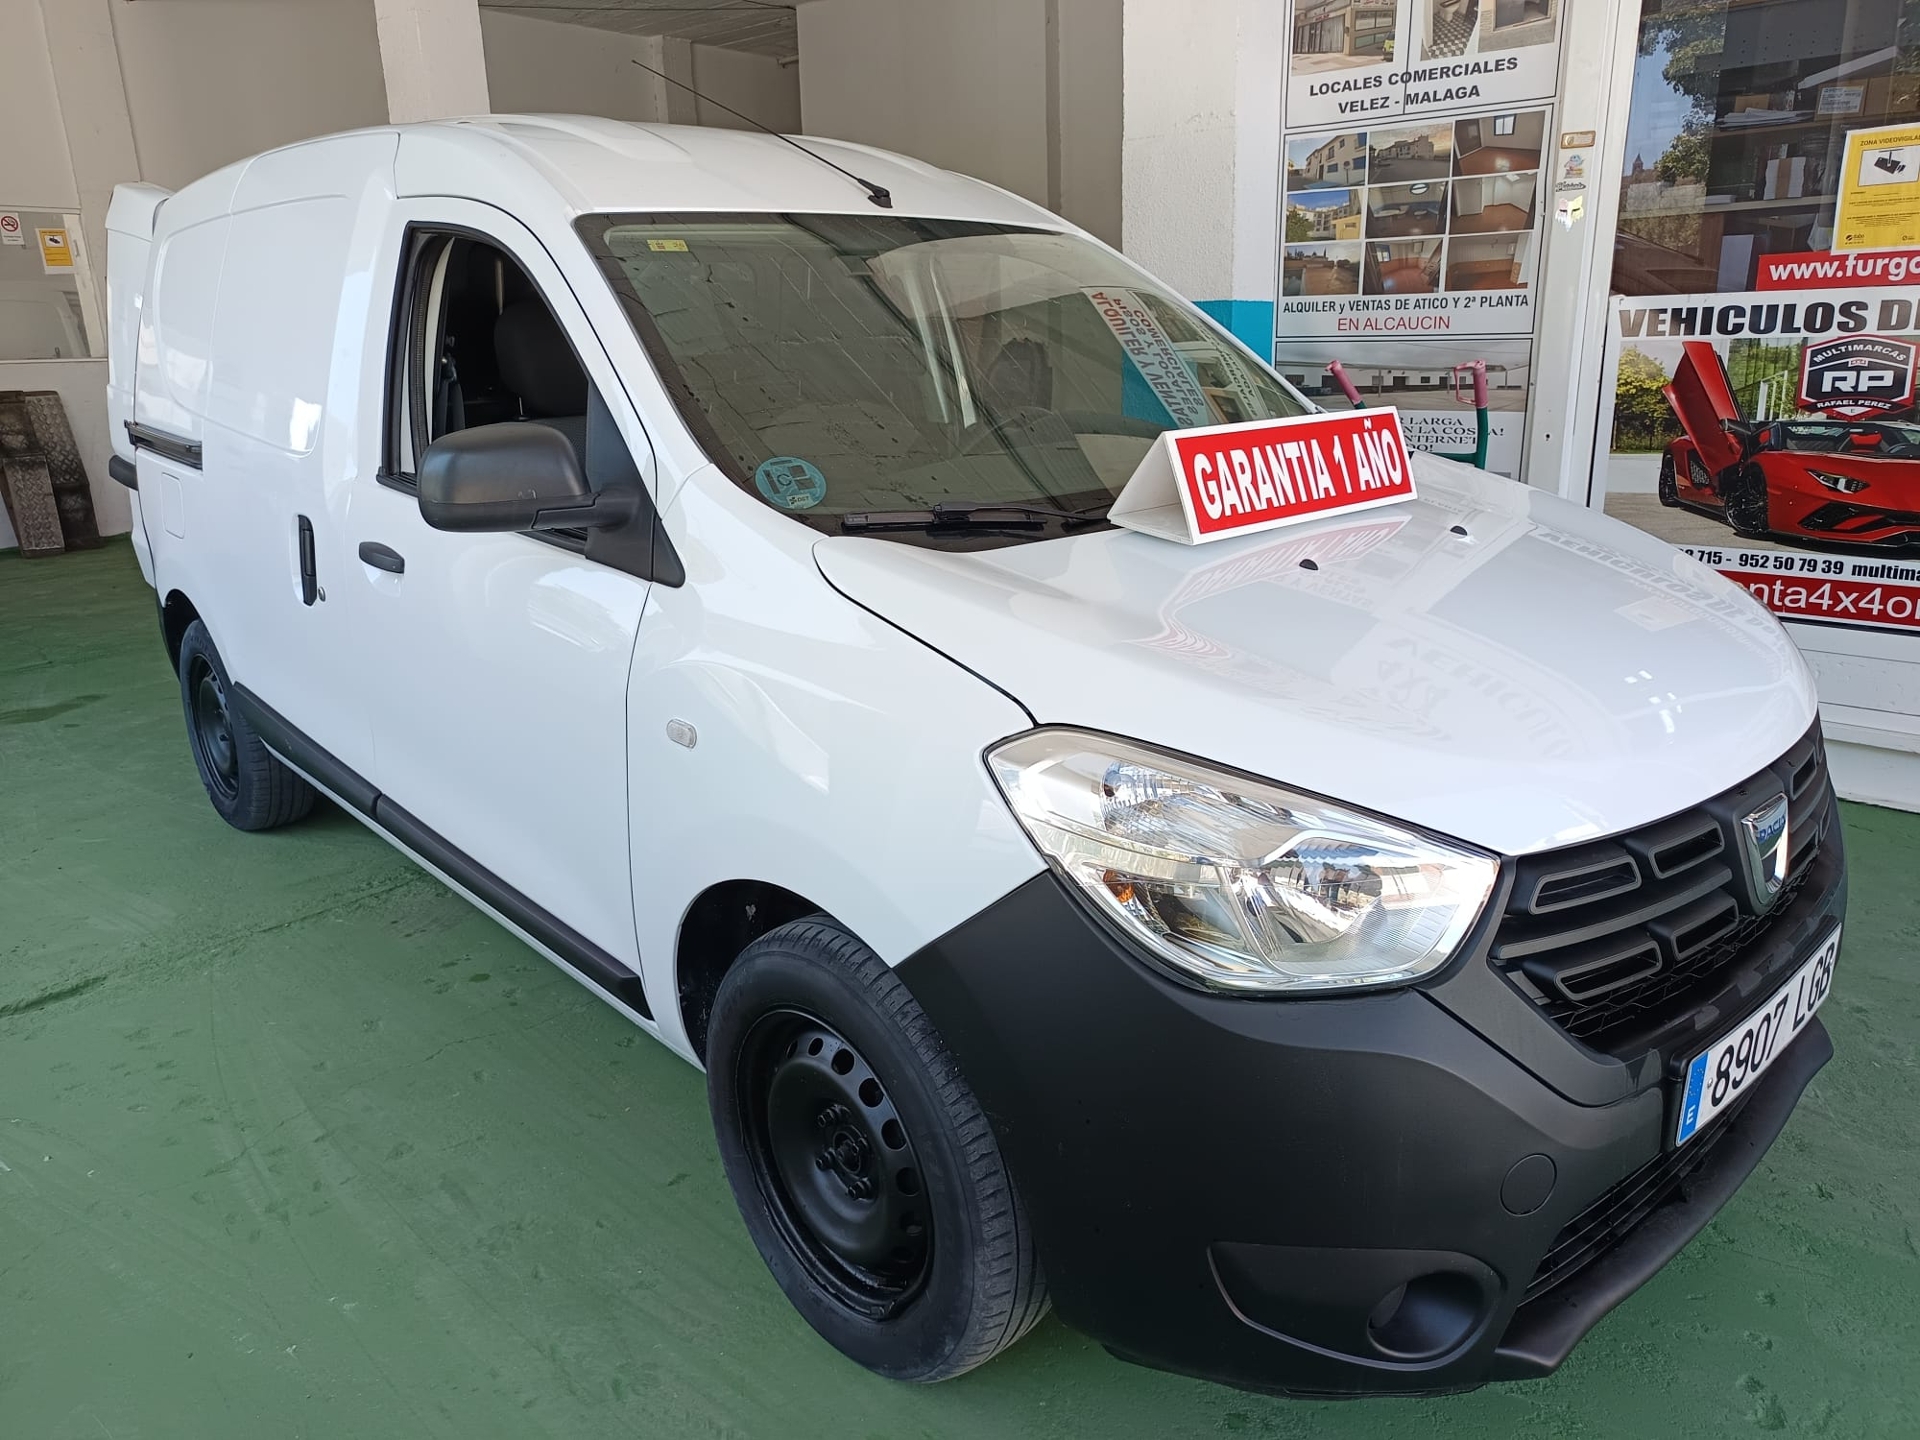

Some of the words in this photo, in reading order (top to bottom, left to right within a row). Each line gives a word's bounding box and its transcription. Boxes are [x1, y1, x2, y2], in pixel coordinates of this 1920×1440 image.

[1309, 75, 1383, 97] LOCALES
[1388, 57, 1518, 85] COMERCIALES
[1338, 96, 1391, 114] VELEZ
[1405, 85, 1480, 106] MALAGA
[1283, 301, 1336, 313] ALQUILER
[1339, 303, 1346, 314] y
[1348, 299, 1391, 312] VENTAS
[1395, 298, 1410, 310] DE
[1413, 297, 1449, 310] ATICO
[1452, 297, 1461, 309] Y
[1480, 294, 1529, 308] PLANTA
[1337, 317, 1359, 331] EN
[1363, 315, 1450, 331] ALCAUCIN
[1619, 301, 1869, 338] VEHICULOS
[1877, 299, 1920, 332] D
[1812, 344, 1907, 363] MULTIMARCAS
[1821, 370, 1895, 392] RP
[1816, 400, 1856, 408] RAFAEL
[1858, 400, 1892, 409] PEREZ
[1409, 417, 1464, 426] LARGA
[1419, 426, 1439, 434] LA
[1442, 427, 1504, 436] COSA!
[1403, 434, 1476, 445] NTERNET
[1193, 438, 1336, 520] GARANTIA
[1333, 435, 1353, 494] 1
[1352, 418, 1404, 492] AÑO
[1738, 553, 1769, 569] 952
[1773, 556, 1795, 571] 50
[1799, 558, 1818, 573] 79
[1821, 560, 1844, 575] 39
[1749, 579, 1920, 620] nta4x4o
[1711, 992, 1790, 1108] 8907
[1792, 941, 1836, 1033] LGB
[1685, 1104, 1696, 1125] E
